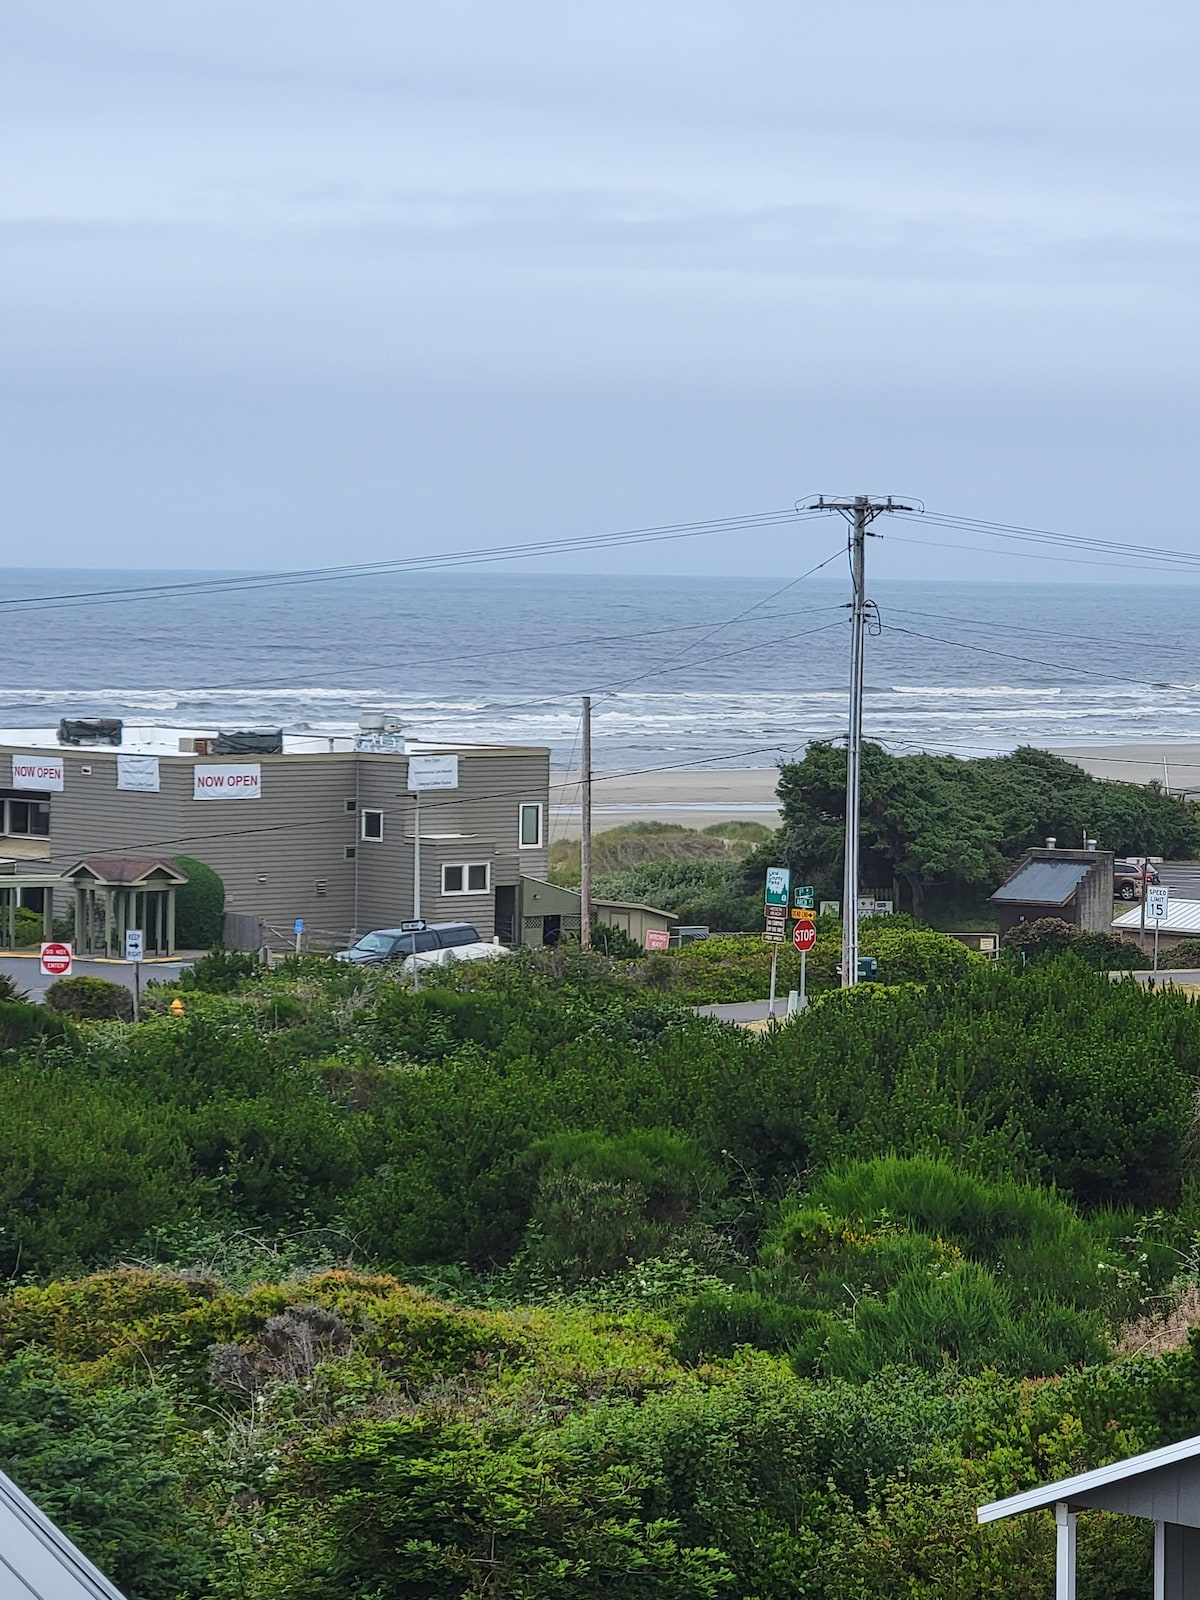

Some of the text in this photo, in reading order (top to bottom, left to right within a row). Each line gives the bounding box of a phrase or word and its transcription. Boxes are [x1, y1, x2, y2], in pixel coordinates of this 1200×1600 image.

[14, 766, 61, 779] NOW OPEN
[197, 775, 258, 788] NOW OPEN
[1151, 903, 1164, 916] 15
[795, 929, 815, 942] STOP
